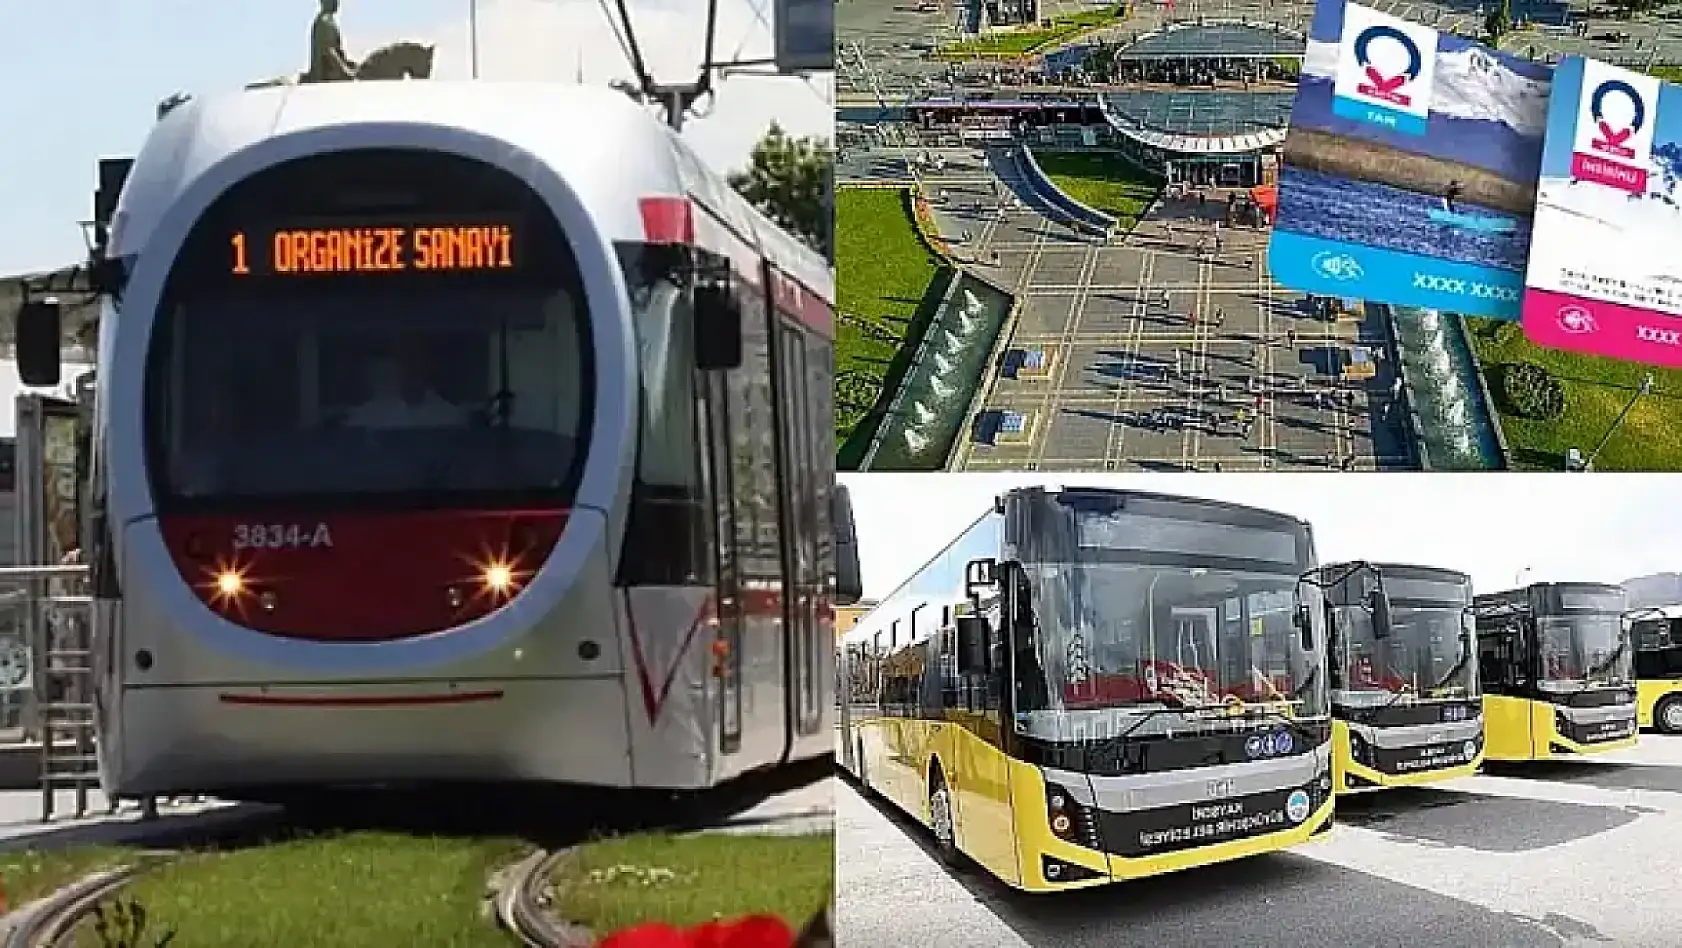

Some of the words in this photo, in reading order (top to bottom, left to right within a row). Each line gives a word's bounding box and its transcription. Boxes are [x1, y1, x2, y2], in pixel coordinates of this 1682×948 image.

[231, 232, 249, 273] 1
[274, 228, 406, 272] ORGANİZE
[414, 225, 513, 268] SANAYİ
[1413, 271, 1466, 295] XXXX
[234, 522, 334, 549] 3834-A
